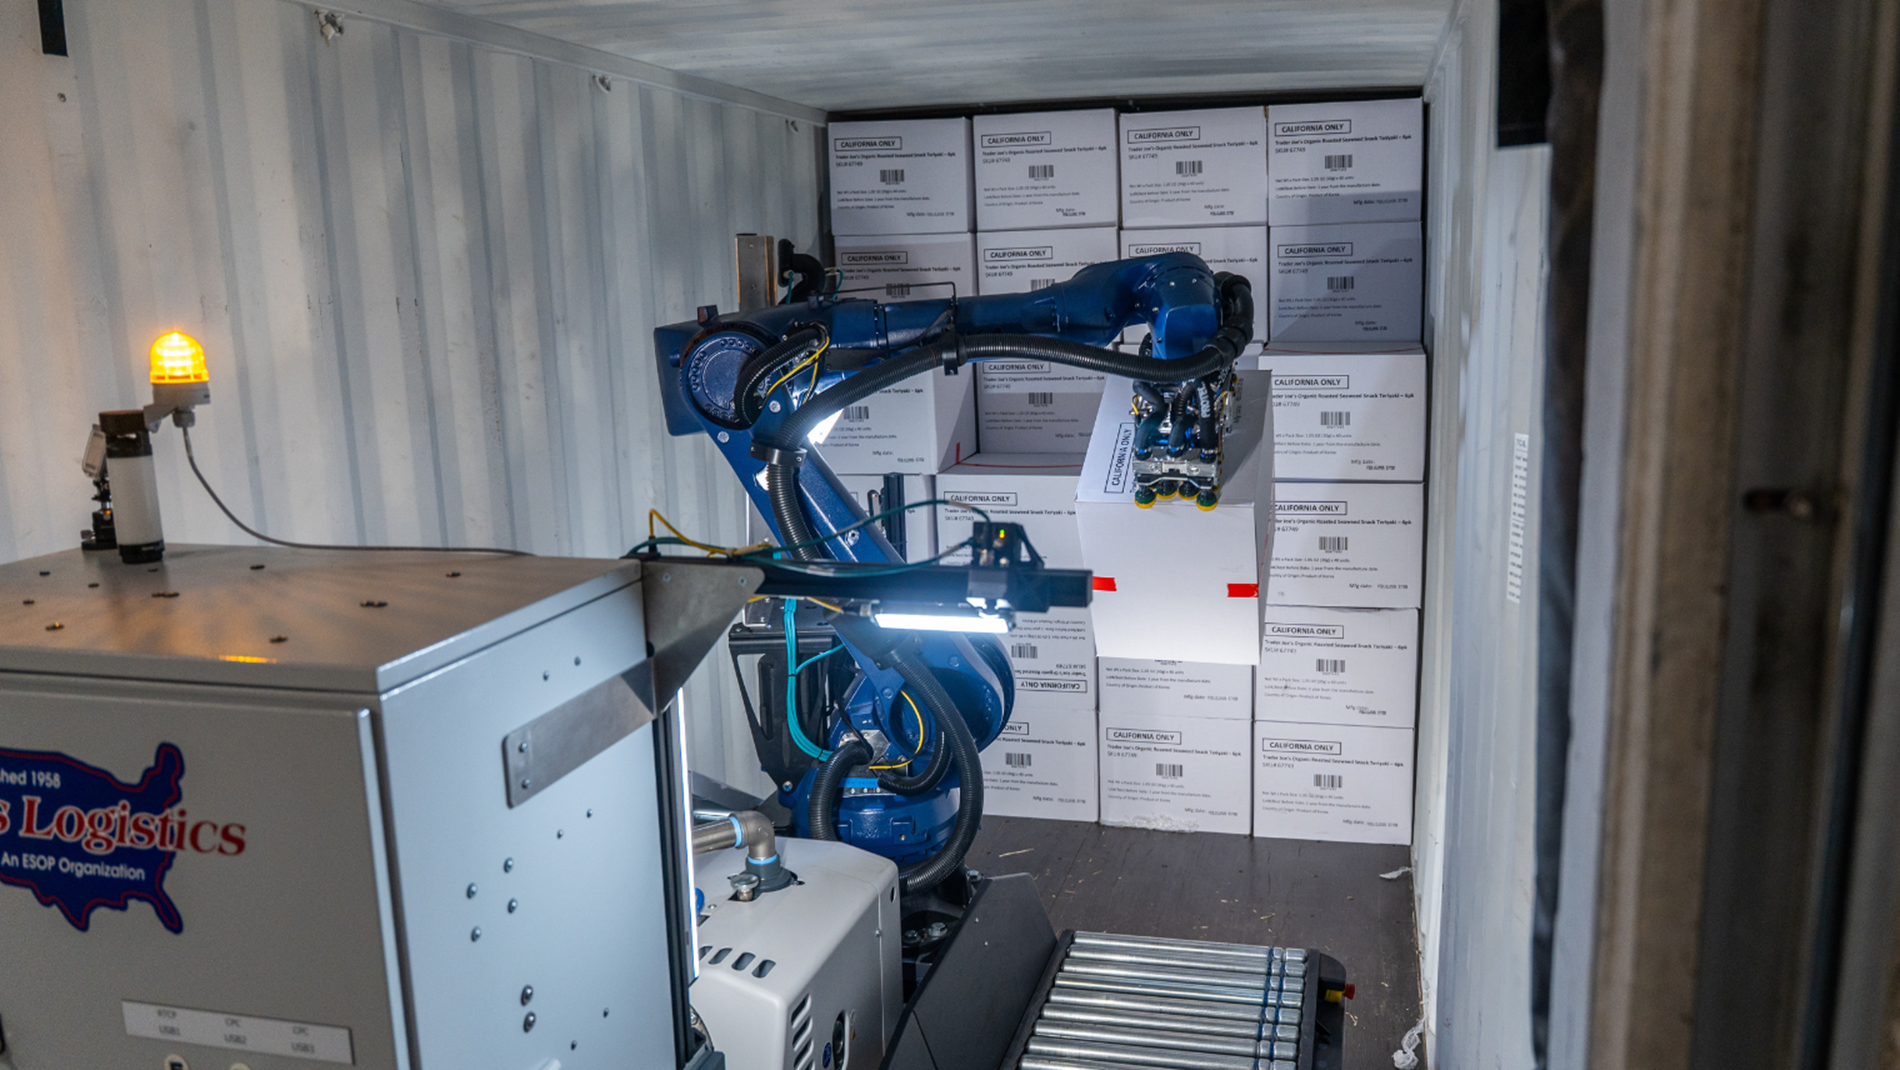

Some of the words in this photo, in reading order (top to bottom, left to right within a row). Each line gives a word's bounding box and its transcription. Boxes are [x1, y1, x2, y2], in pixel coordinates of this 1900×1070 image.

[1112, 446, 1127, 486] CALIFORNIA
[1121, 428, 1132, 445] ONLY
[1113, 732, 1154, 740] CALIFORNIA
[32, 771, 60, 788] 1958
[19, 796, 246, 856] Logistics
[2, 853, 19, 867] An
[23, 856, 54, 871] ESOP
[58, 858, 145, 881] Organization
